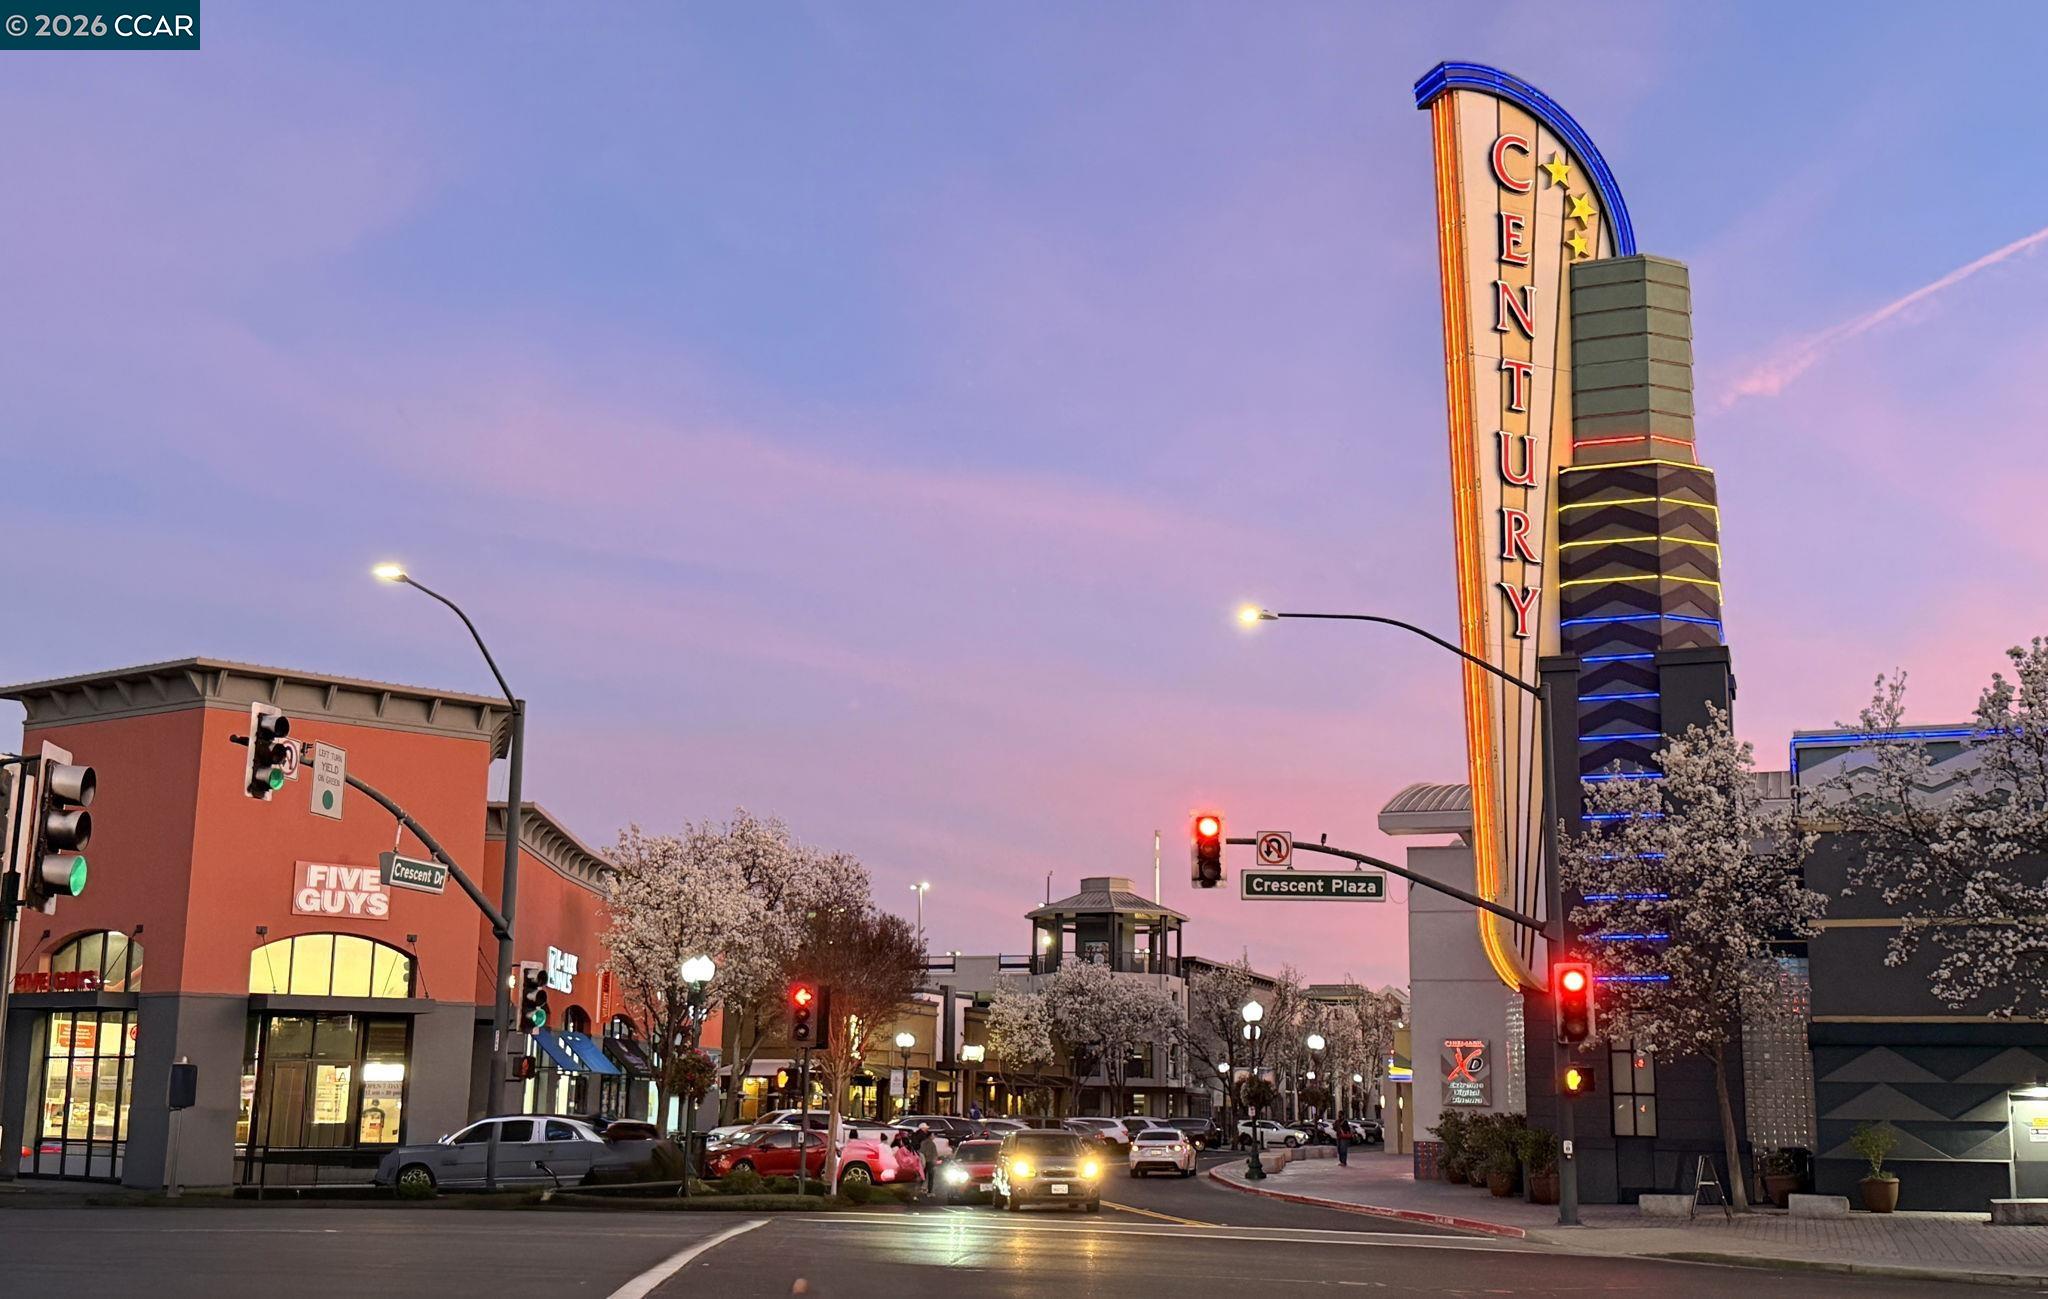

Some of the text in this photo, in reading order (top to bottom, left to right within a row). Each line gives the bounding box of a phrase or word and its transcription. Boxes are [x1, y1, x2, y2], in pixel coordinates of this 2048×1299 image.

[1493, 133, 1542, 637] CENTURY
[319, 749, 343, 762] LEFT TURN
[322, 766, 339, 780] YIELD
[326, 775, 340, 786] GREEN
[306, 864, 381, 891] FIVE
[394, 863, 444, 885] Crescent Dr
[1252, 878, 1377, 893] Crescent Plaza
[296, 888, 389, 916] GUYS
[1444, 1040, 1485, 1048] CINEMARK
[1447, 1047, 1484, 1082] XD
